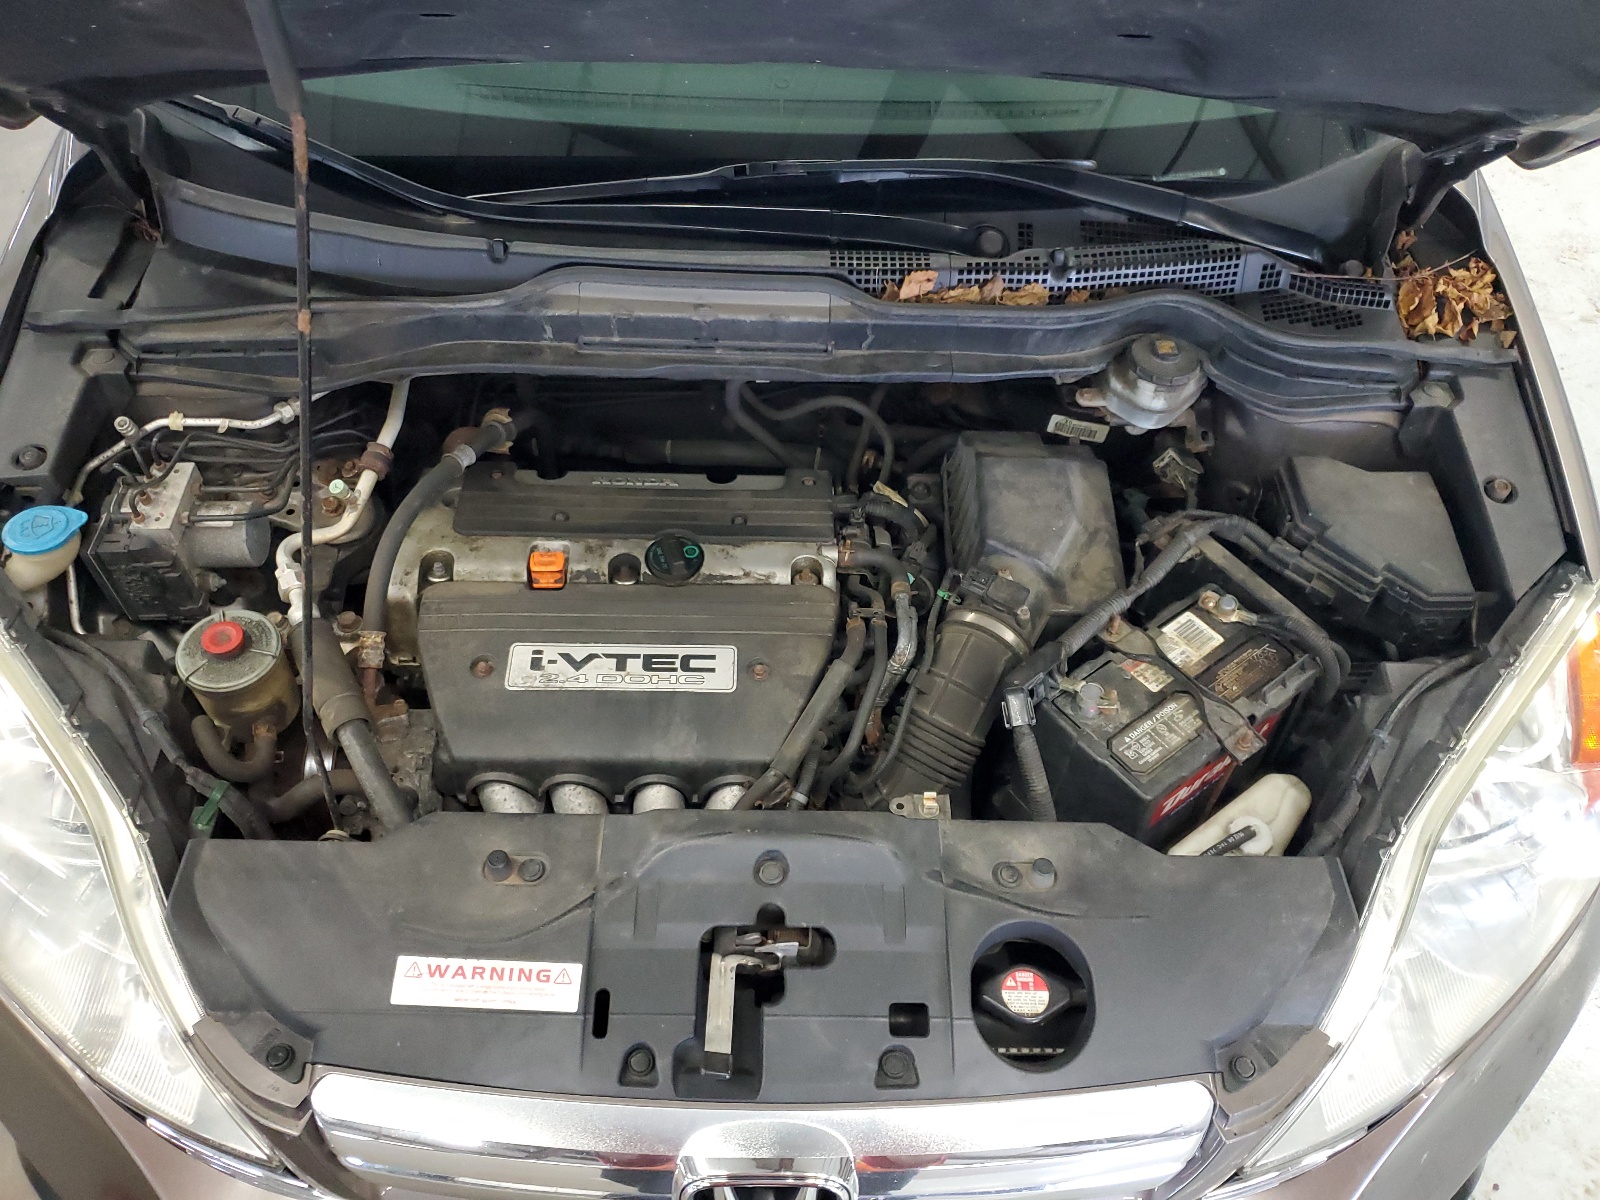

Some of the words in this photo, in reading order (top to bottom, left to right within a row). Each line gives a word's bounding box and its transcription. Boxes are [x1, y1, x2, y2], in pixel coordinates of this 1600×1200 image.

[592, 477, 679, 487] HONDA
[529, 649, 717, 674] i-VTEC
[539, 673, 589, 685] 2.4
[595, 673, 706, 685] DOHC
[1128, 719, 1154, 740] DANGER
[1155, 702, 1179, 720] POISON
[427, 963, 552, 983] WARNING
